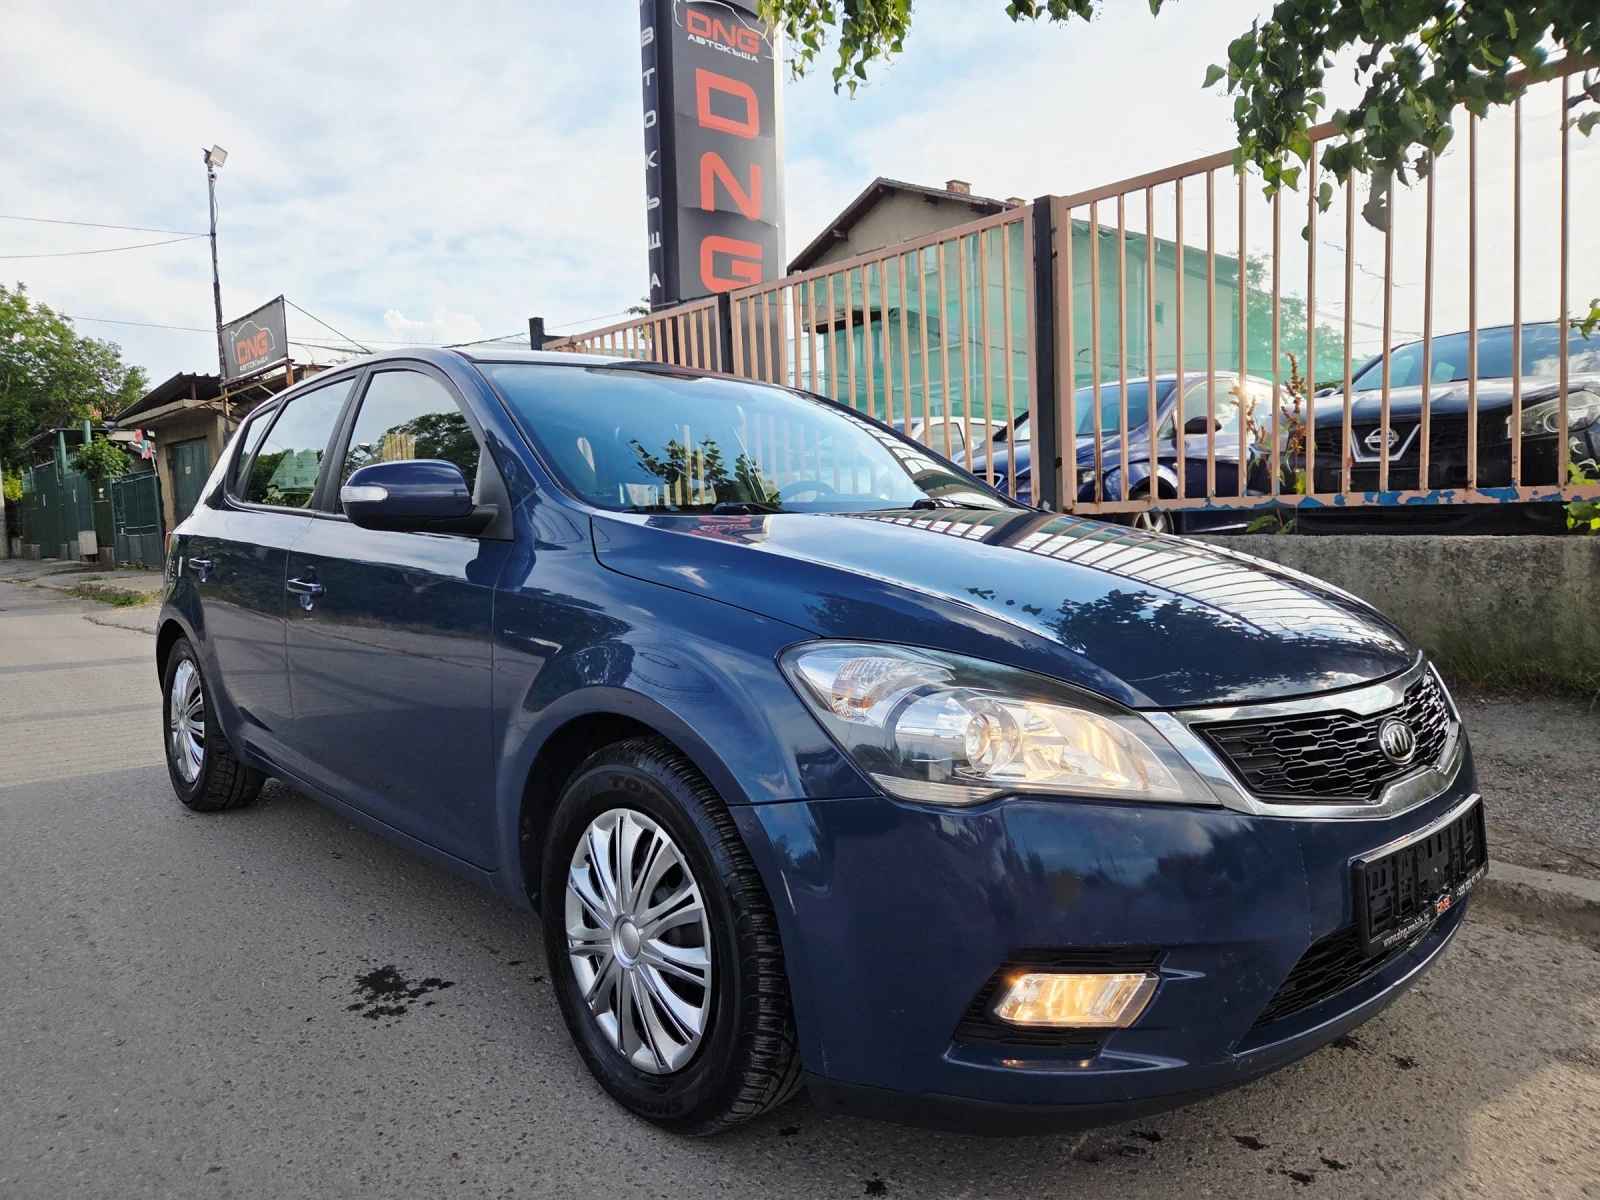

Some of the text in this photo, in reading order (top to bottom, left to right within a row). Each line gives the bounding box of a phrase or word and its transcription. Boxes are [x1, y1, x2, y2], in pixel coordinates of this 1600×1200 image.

[686, 9, 760, 55] DNG
[695, 68, 762, 294] DNG
[236, 330, 268, 365] DNG
